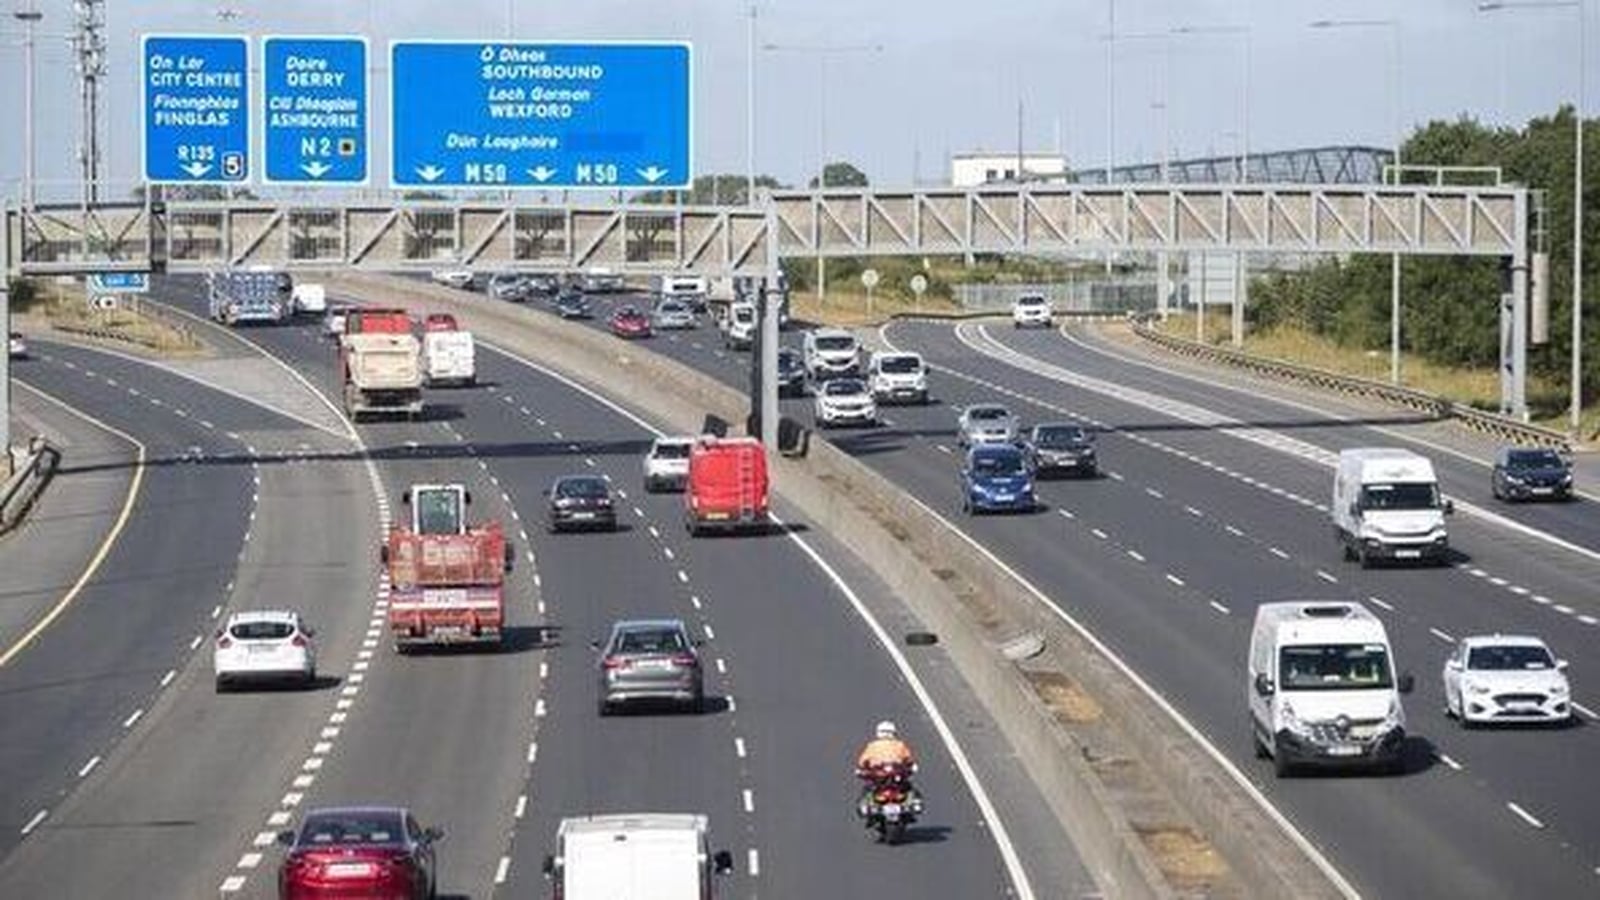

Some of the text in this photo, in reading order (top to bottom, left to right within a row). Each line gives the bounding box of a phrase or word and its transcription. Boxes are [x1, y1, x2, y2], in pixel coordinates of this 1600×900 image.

[151, 72, 241, 87] CITY CENTRE
[287, 72, 344, 87] DERRY
[482, 65, 603, 79] SOUTHBOUND
[490, 103, 572, 118] WEXFORD
[155, 111, 229, 126] FINGLAS
[270, 113, 358, 128] ASHBOURNE
[178, 145, 214, 160] R135
[226, 156, 240, 175] 5
